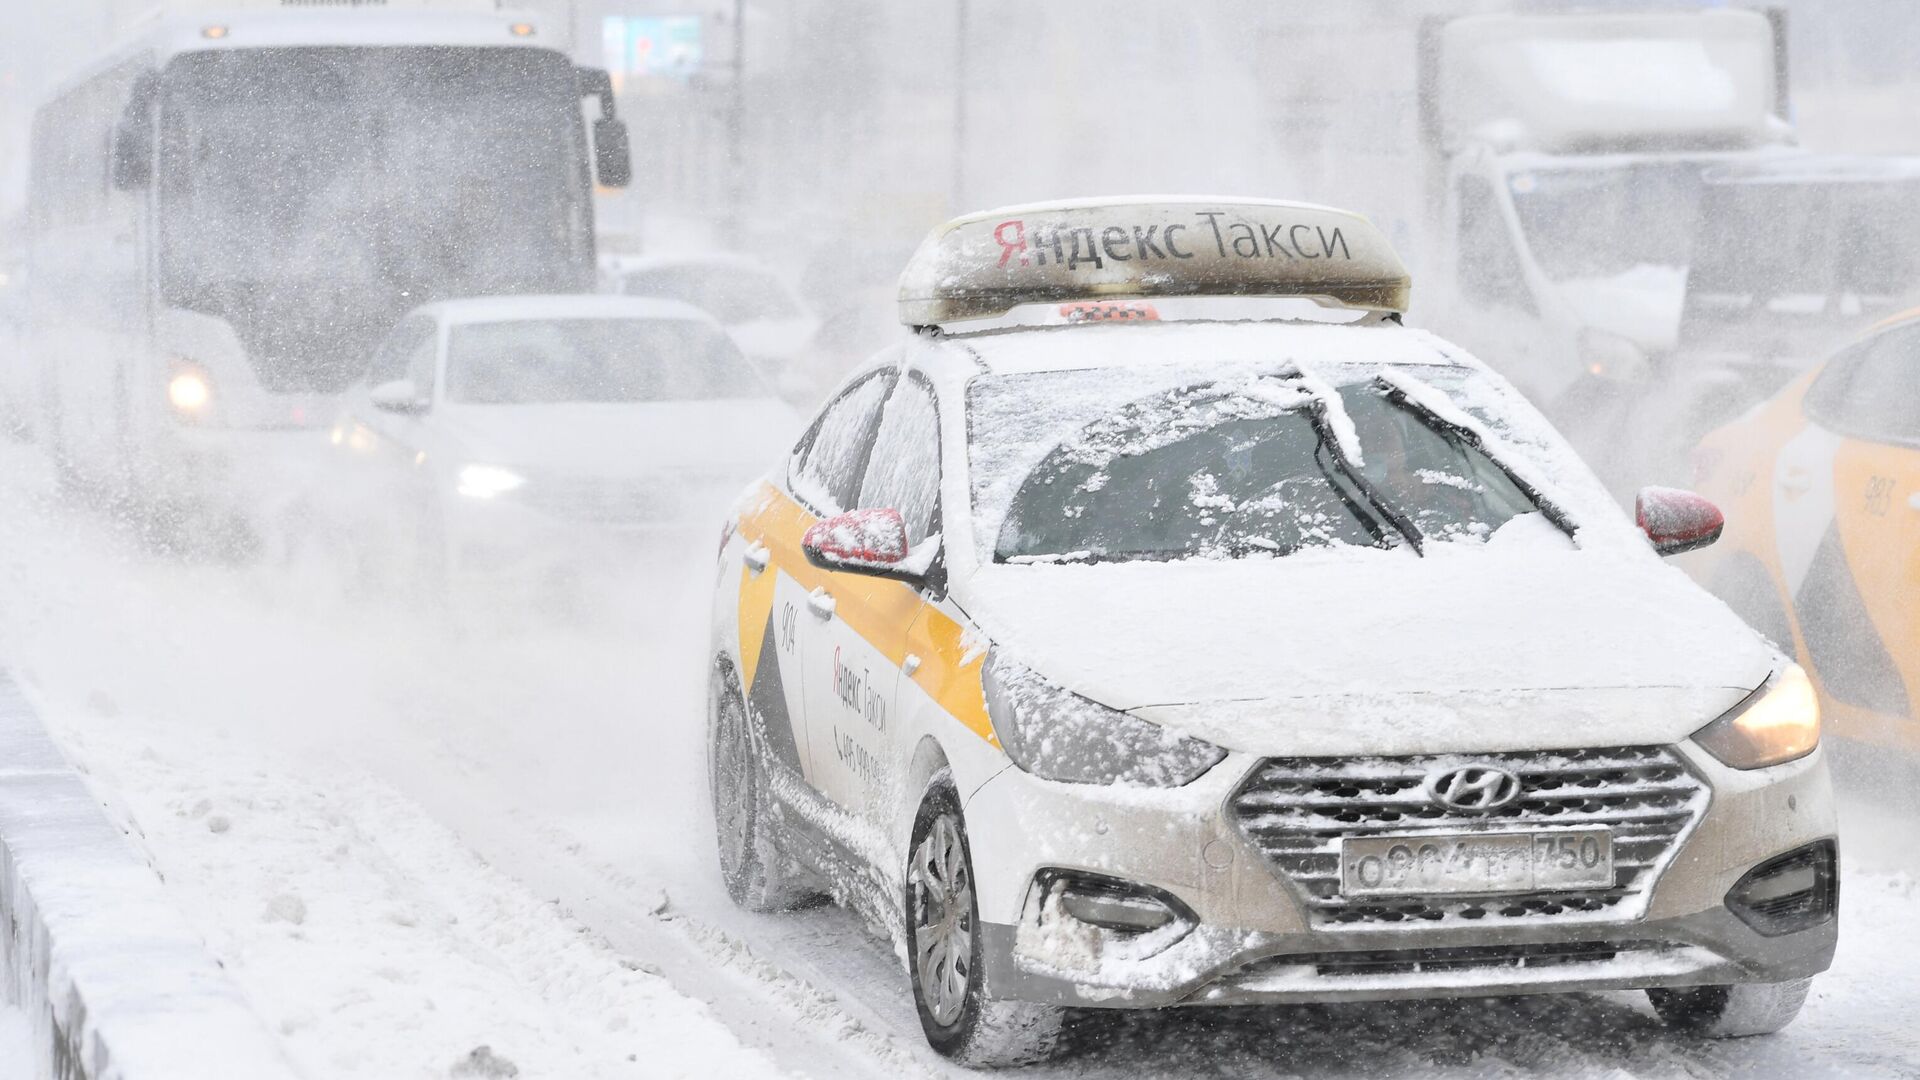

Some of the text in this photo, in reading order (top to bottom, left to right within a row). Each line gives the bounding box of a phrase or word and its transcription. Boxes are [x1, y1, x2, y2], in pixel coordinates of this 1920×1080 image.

[993, 211, 1352, 270] Яндекс Такси
[781, 600, 798, 656] 904
[833, 645, 886, 735] Яндекс Такси
[1535, 836, 1600, 869] 750
